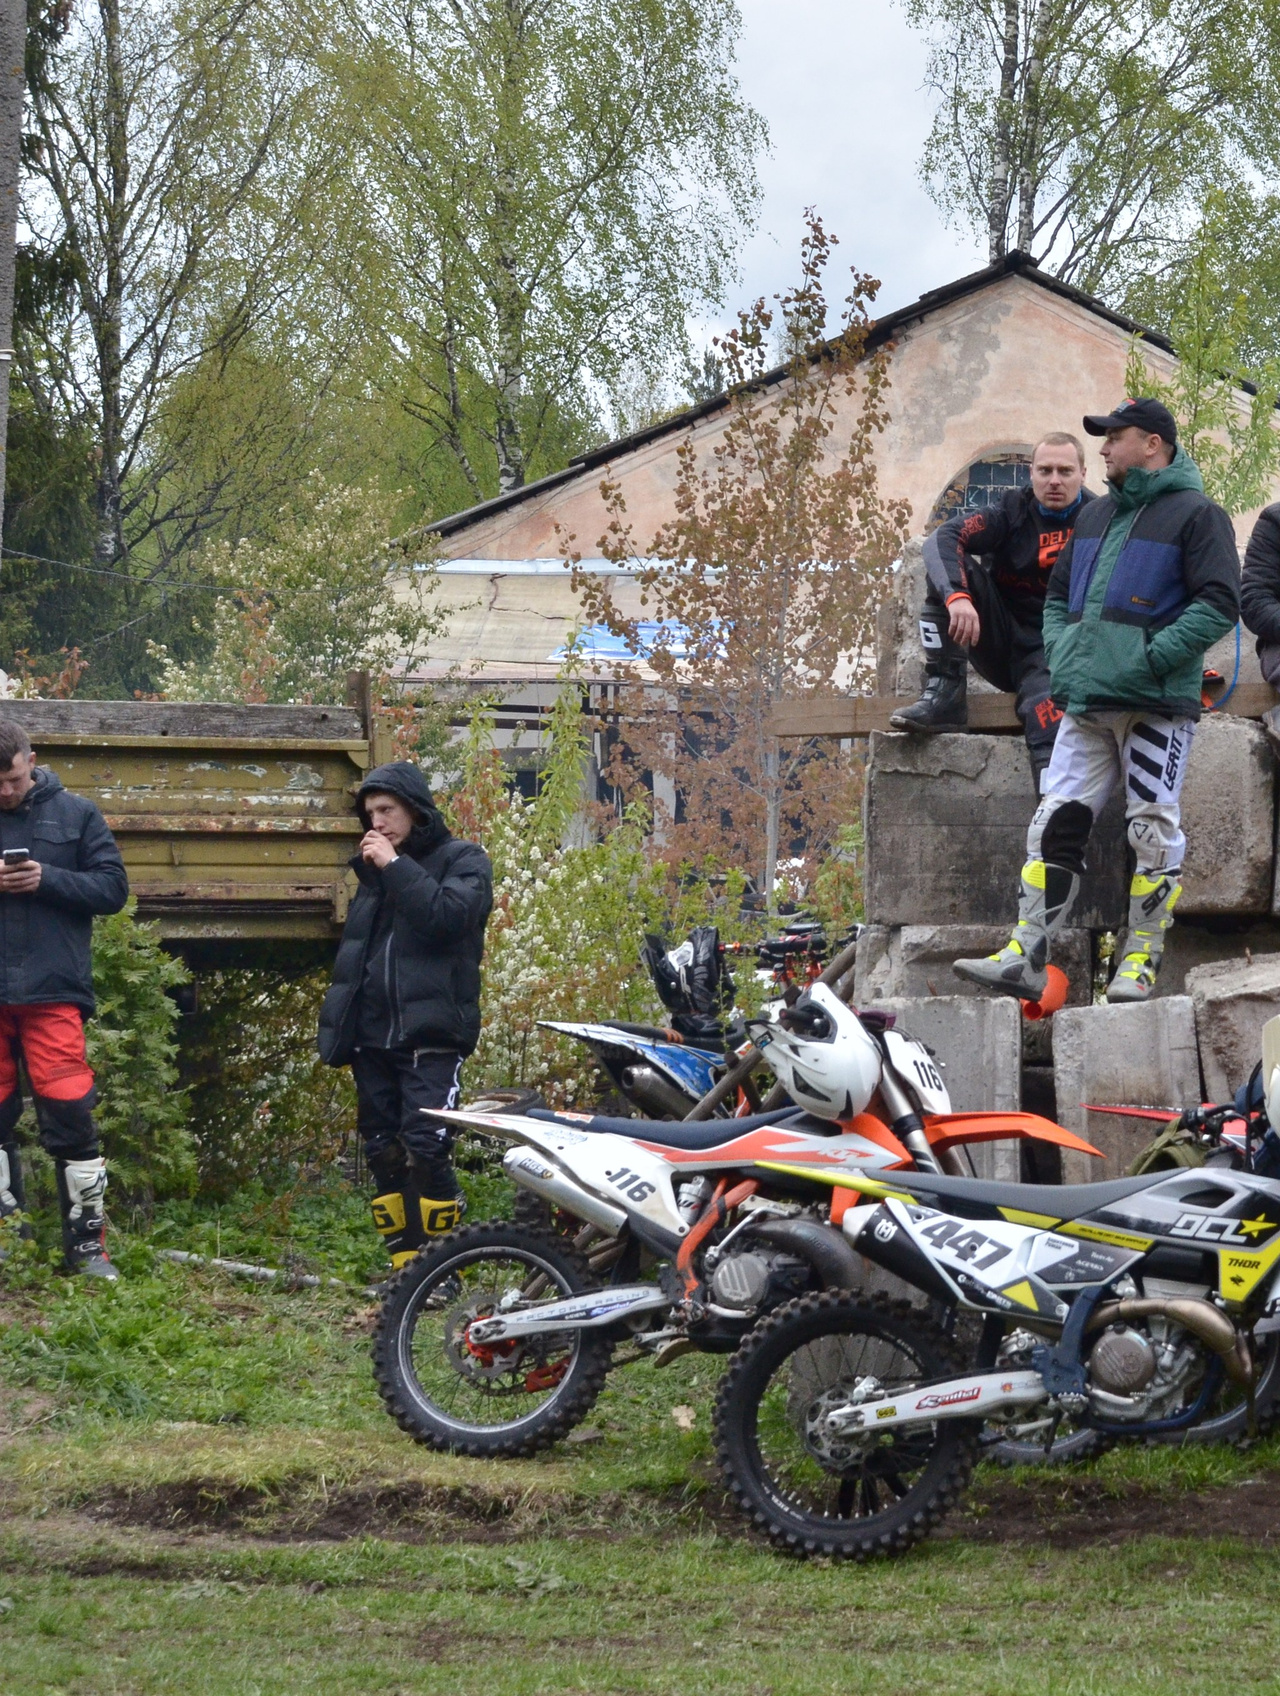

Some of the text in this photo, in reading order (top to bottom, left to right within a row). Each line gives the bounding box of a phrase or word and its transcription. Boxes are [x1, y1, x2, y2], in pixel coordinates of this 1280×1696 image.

[1163, 729, 1183, 791] LEATT
[913, 1059, 944, 1092] 116
[607, 1167, 656, 1203] 116
[920, 1219, 1013, 1271] 447
[1228, 1258, 1262, 1270] THOR
[516, 1290, 650, 1323] FACTORY RACING
